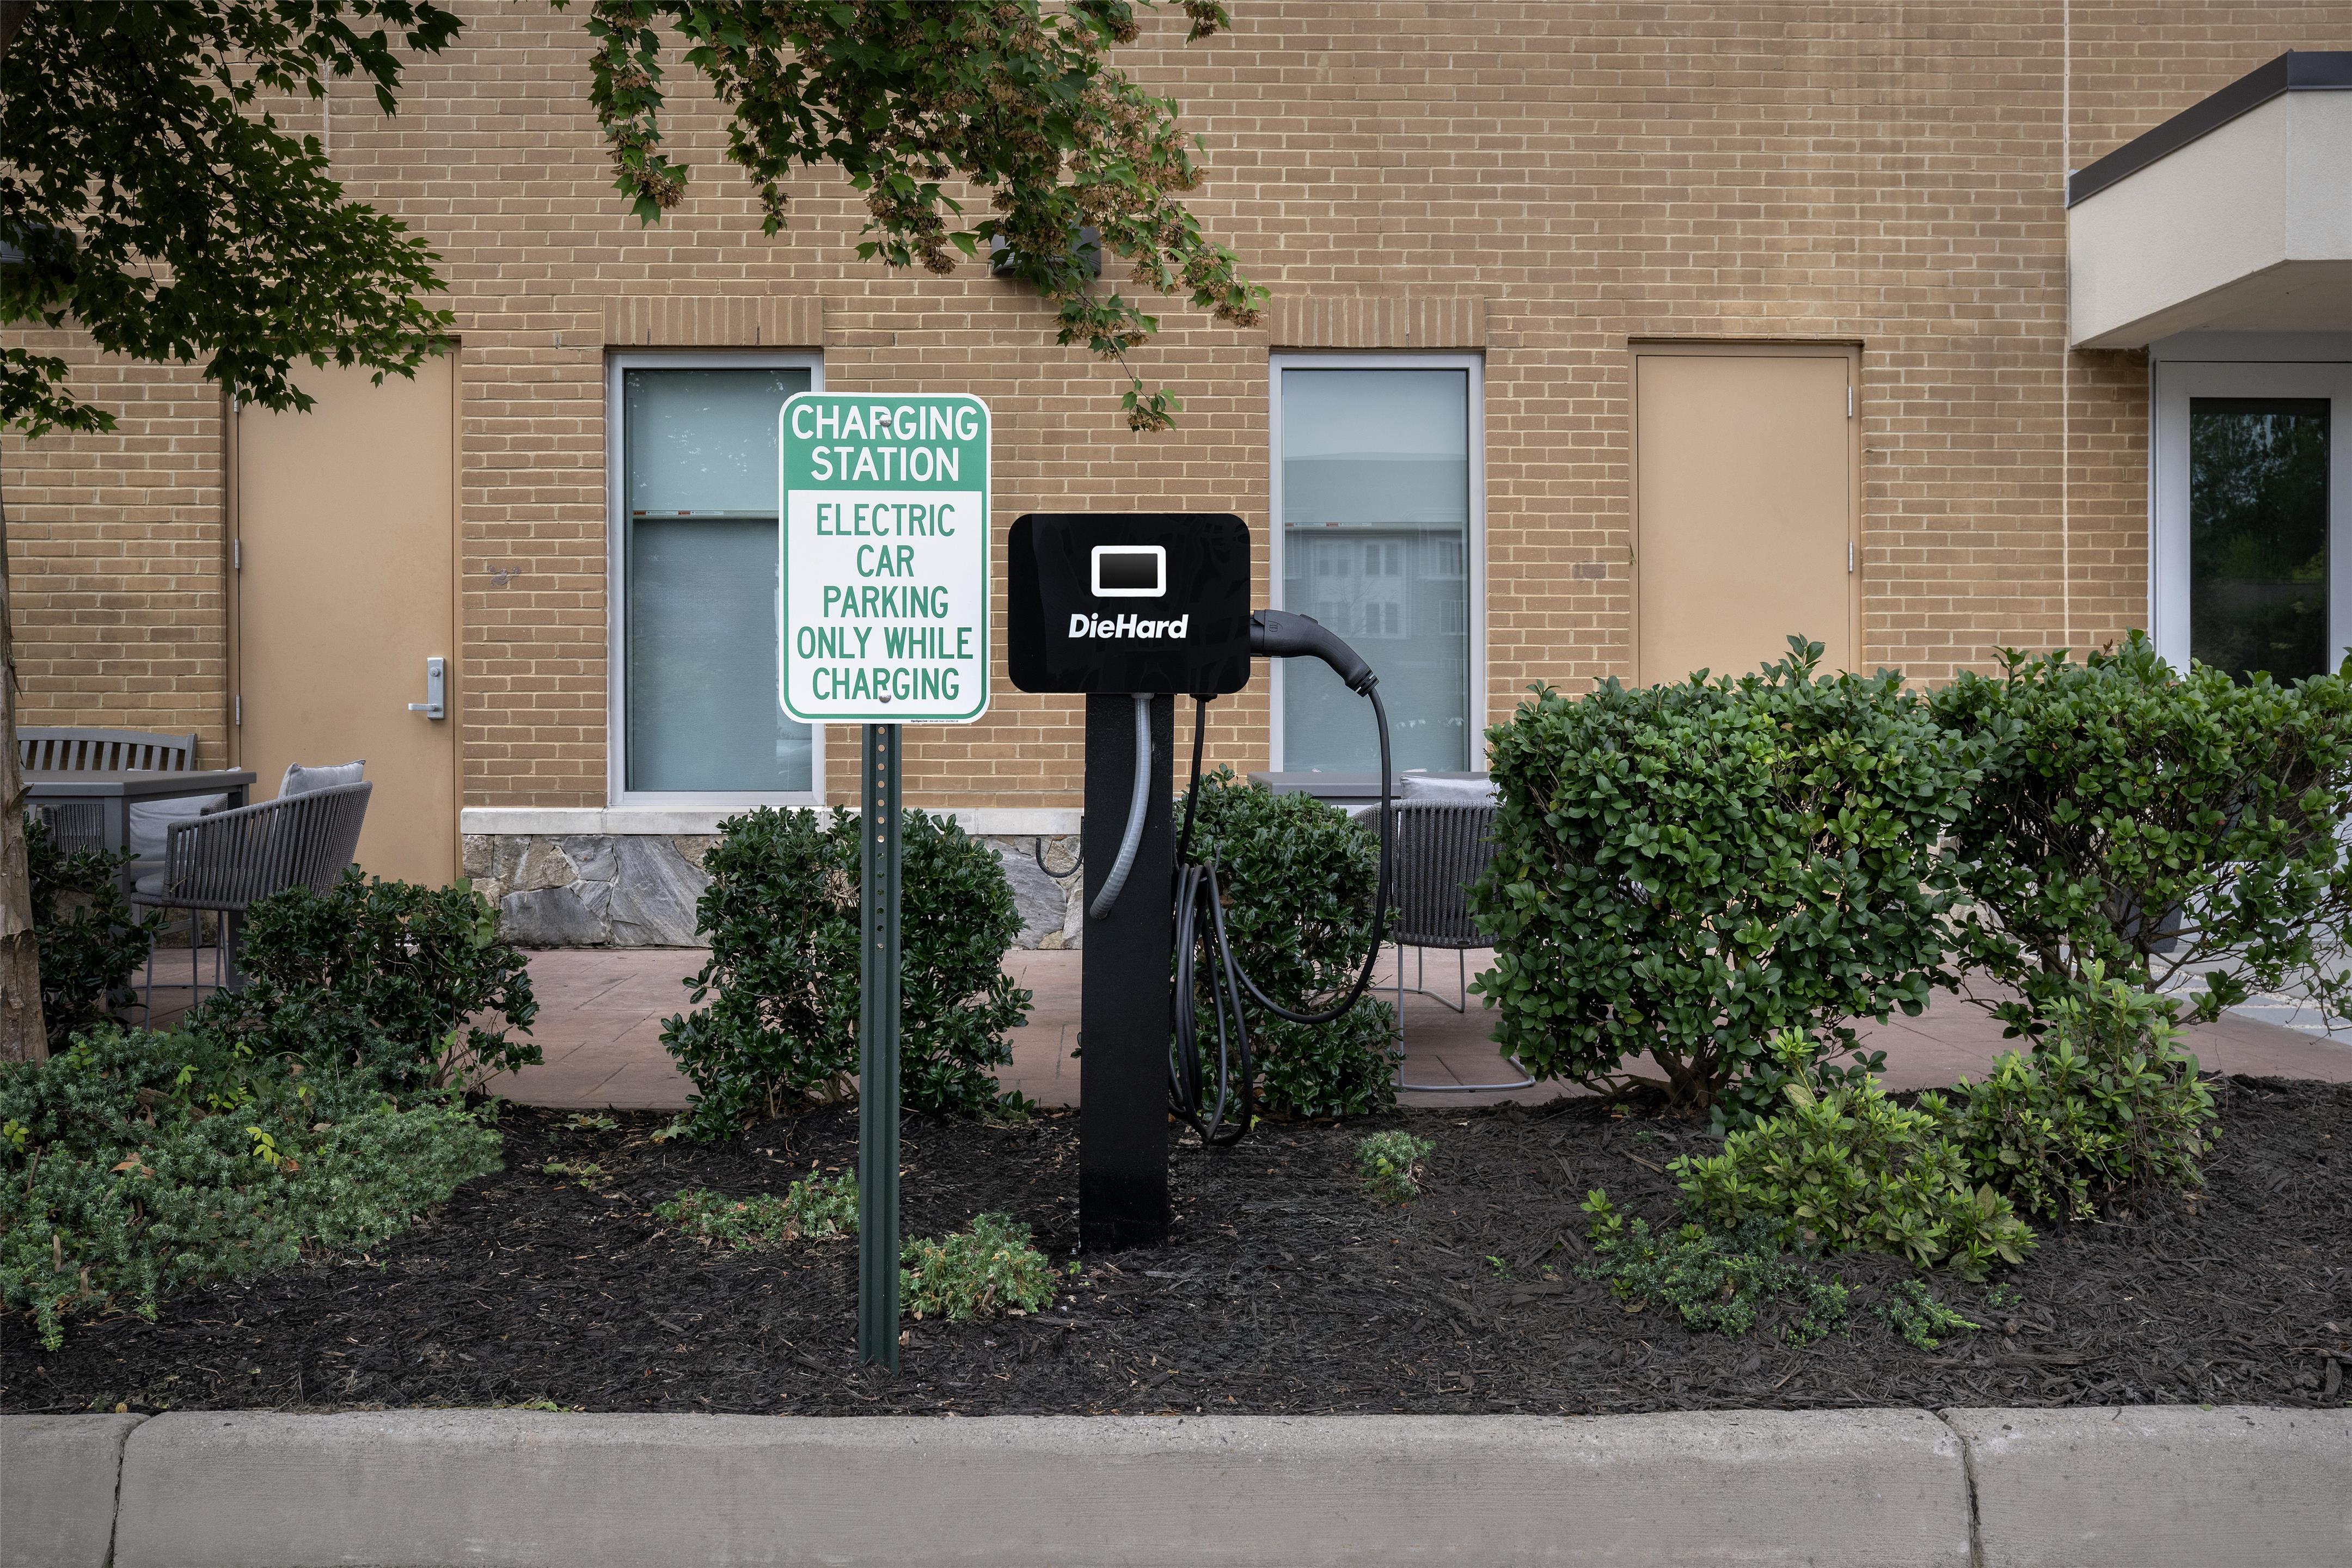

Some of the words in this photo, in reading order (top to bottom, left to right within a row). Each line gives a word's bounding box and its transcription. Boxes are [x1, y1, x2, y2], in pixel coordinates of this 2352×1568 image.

[792, 405, 978, 440] CHARGING
[811, 446, 959, 481] STATION
[817, 503, 955, 536] ELECTRIC
[856, 544, 915, 577] CAR
[823, 585, 948, 618] PARKING
[1068, 612, 1189, 639] DieHard
[797, 626, 872, 659] ONLY
[884, 627, 973, 659] WHILE
[812, 667, 959, 701] CHARGING
